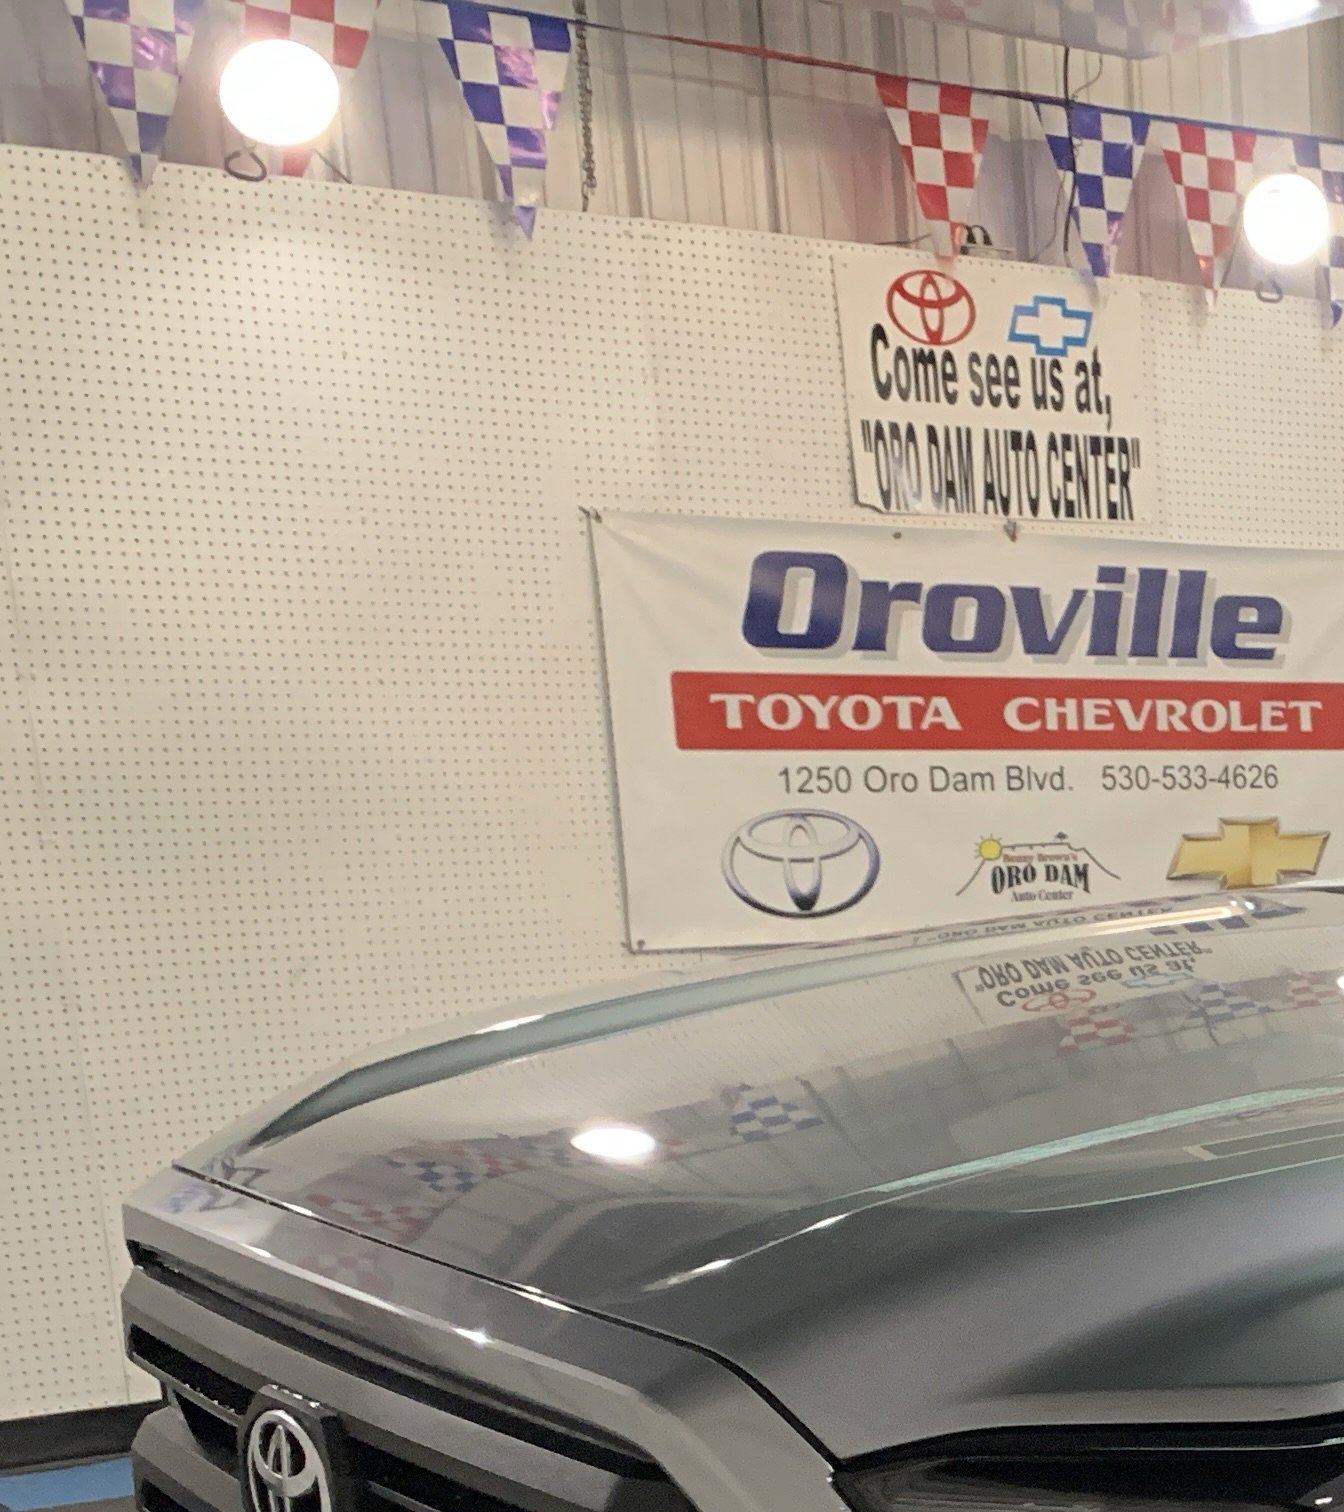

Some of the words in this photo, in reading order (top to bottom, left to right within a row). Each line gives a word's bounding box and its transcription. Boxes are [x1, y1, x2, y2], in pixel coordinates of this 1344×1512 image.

[871, 323, 958, 405] Come
[968, 351, 1020, 409] see
[1030, 357, 1066, 412] us
[1075, 345, 1112, 432] at,
[861, 419, 922, 512] "ORO
[926, 424, 976, 513] DAM
[983, 428, 1041, 518] AUTO
[1048, 431, 1141, 520] CENTER"
[741, 550, 1286, 662] Oroville
[709, 694, 962, 732] TOYOTA
[1003, 697, 1324, 734] CHEVROLET
[778, 767, 852, 795] 1250
[864, 765, 919, 794] Oro
[930, 765, 996, 793] Dam
[1006, 764, 1074, 793] Blvd.
[1101, 764, 1279, 792] 530-533-4626
[991, 864, 1037, 895] ORO
[1045, 863, 1091, 895] DAM
[1011, 891, 1036, 902] Auto
